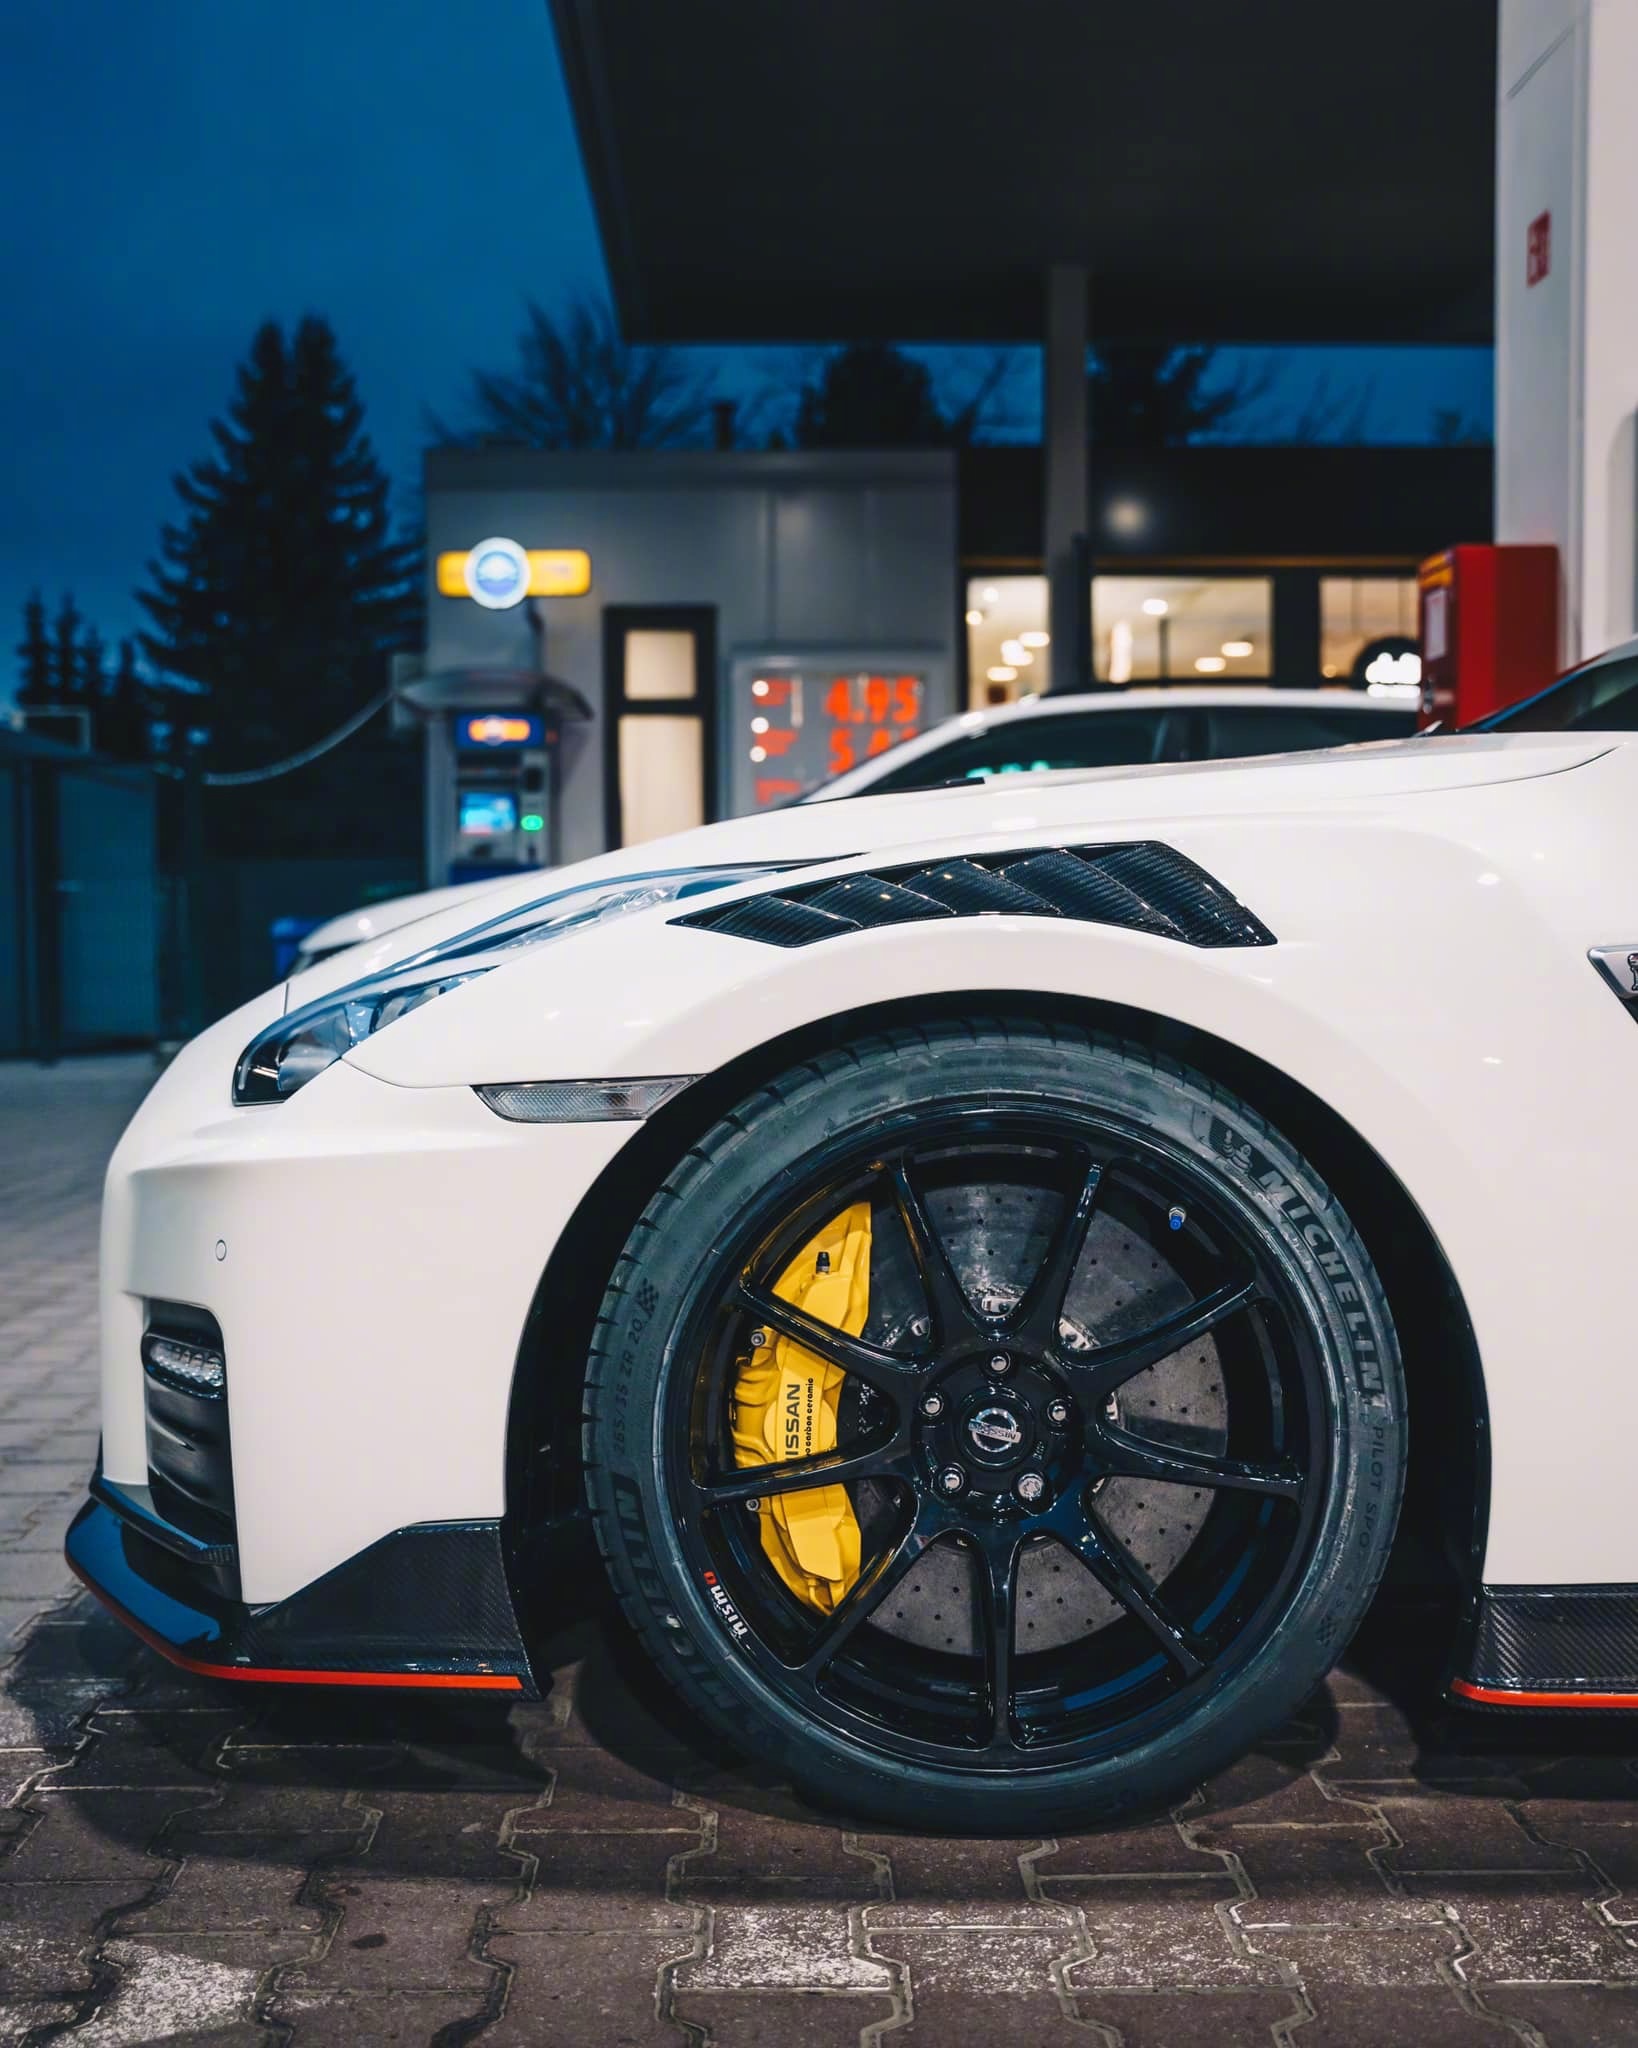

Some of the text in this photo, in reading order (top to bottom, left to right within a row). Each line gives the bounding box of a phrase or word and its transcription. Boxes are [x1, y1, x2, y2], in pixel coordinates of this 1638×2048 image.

[1259, 1170, 1384, 1391] MICHELIN
[628, 1318, 644, 1345] 20
[785, 1384, 801, 1461] ISSAN
[805, 1377, 814, 1414] ceramic
[804, 1415, 813, 1447] carbon
[1371, 1425, 1385, 1492] PILOT
[704, 1571, 748, 1636] nismo
